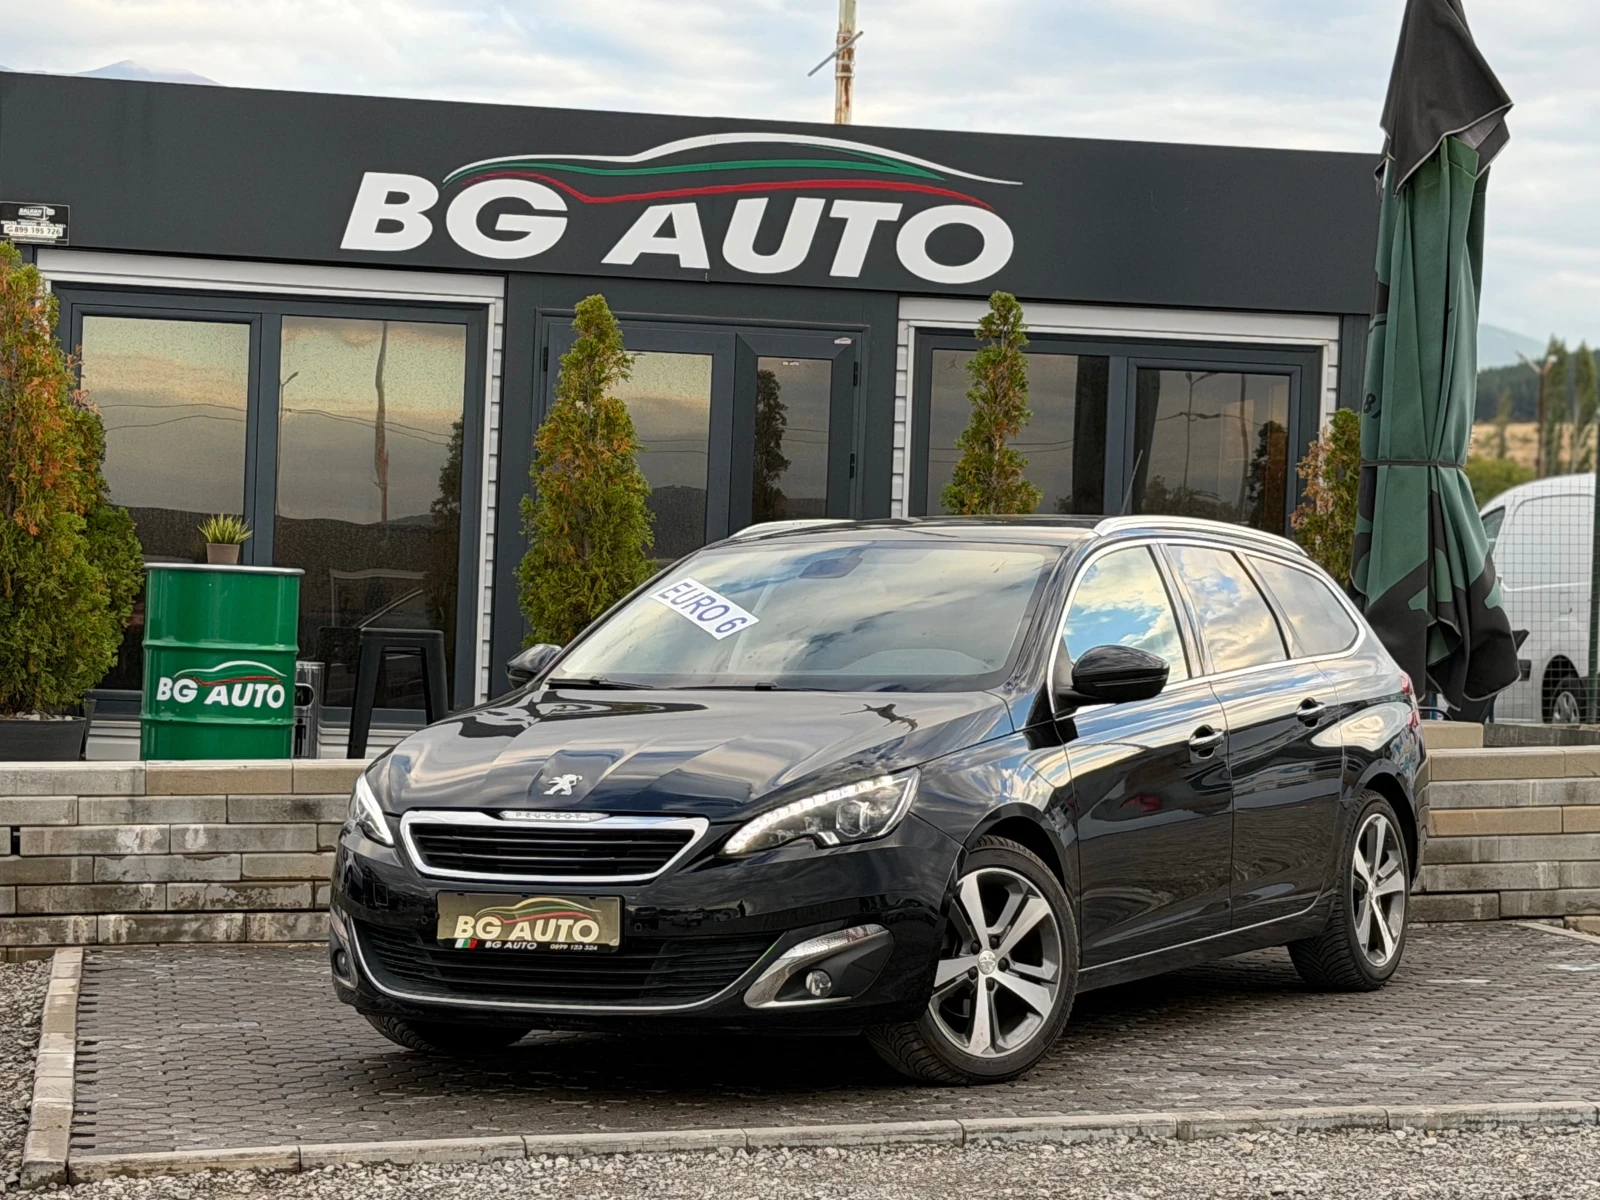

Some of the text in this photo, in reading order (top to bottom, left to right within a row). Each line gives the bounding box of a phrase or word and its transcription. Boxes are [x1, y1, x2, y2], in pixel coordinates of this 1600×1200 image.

[14, 226, 61, 236] 899 195 726
[340, 172, 1014, 284] BG AUTO
[657, 582, 748, 633] EURO 6
[156, 677, 285, 708] BG AUTO
[516, 812, 582, 820] PEUGEOT
[454, 915, 600, 943] BG AUTO
[484, 941, 537, 950] BG AUTO
